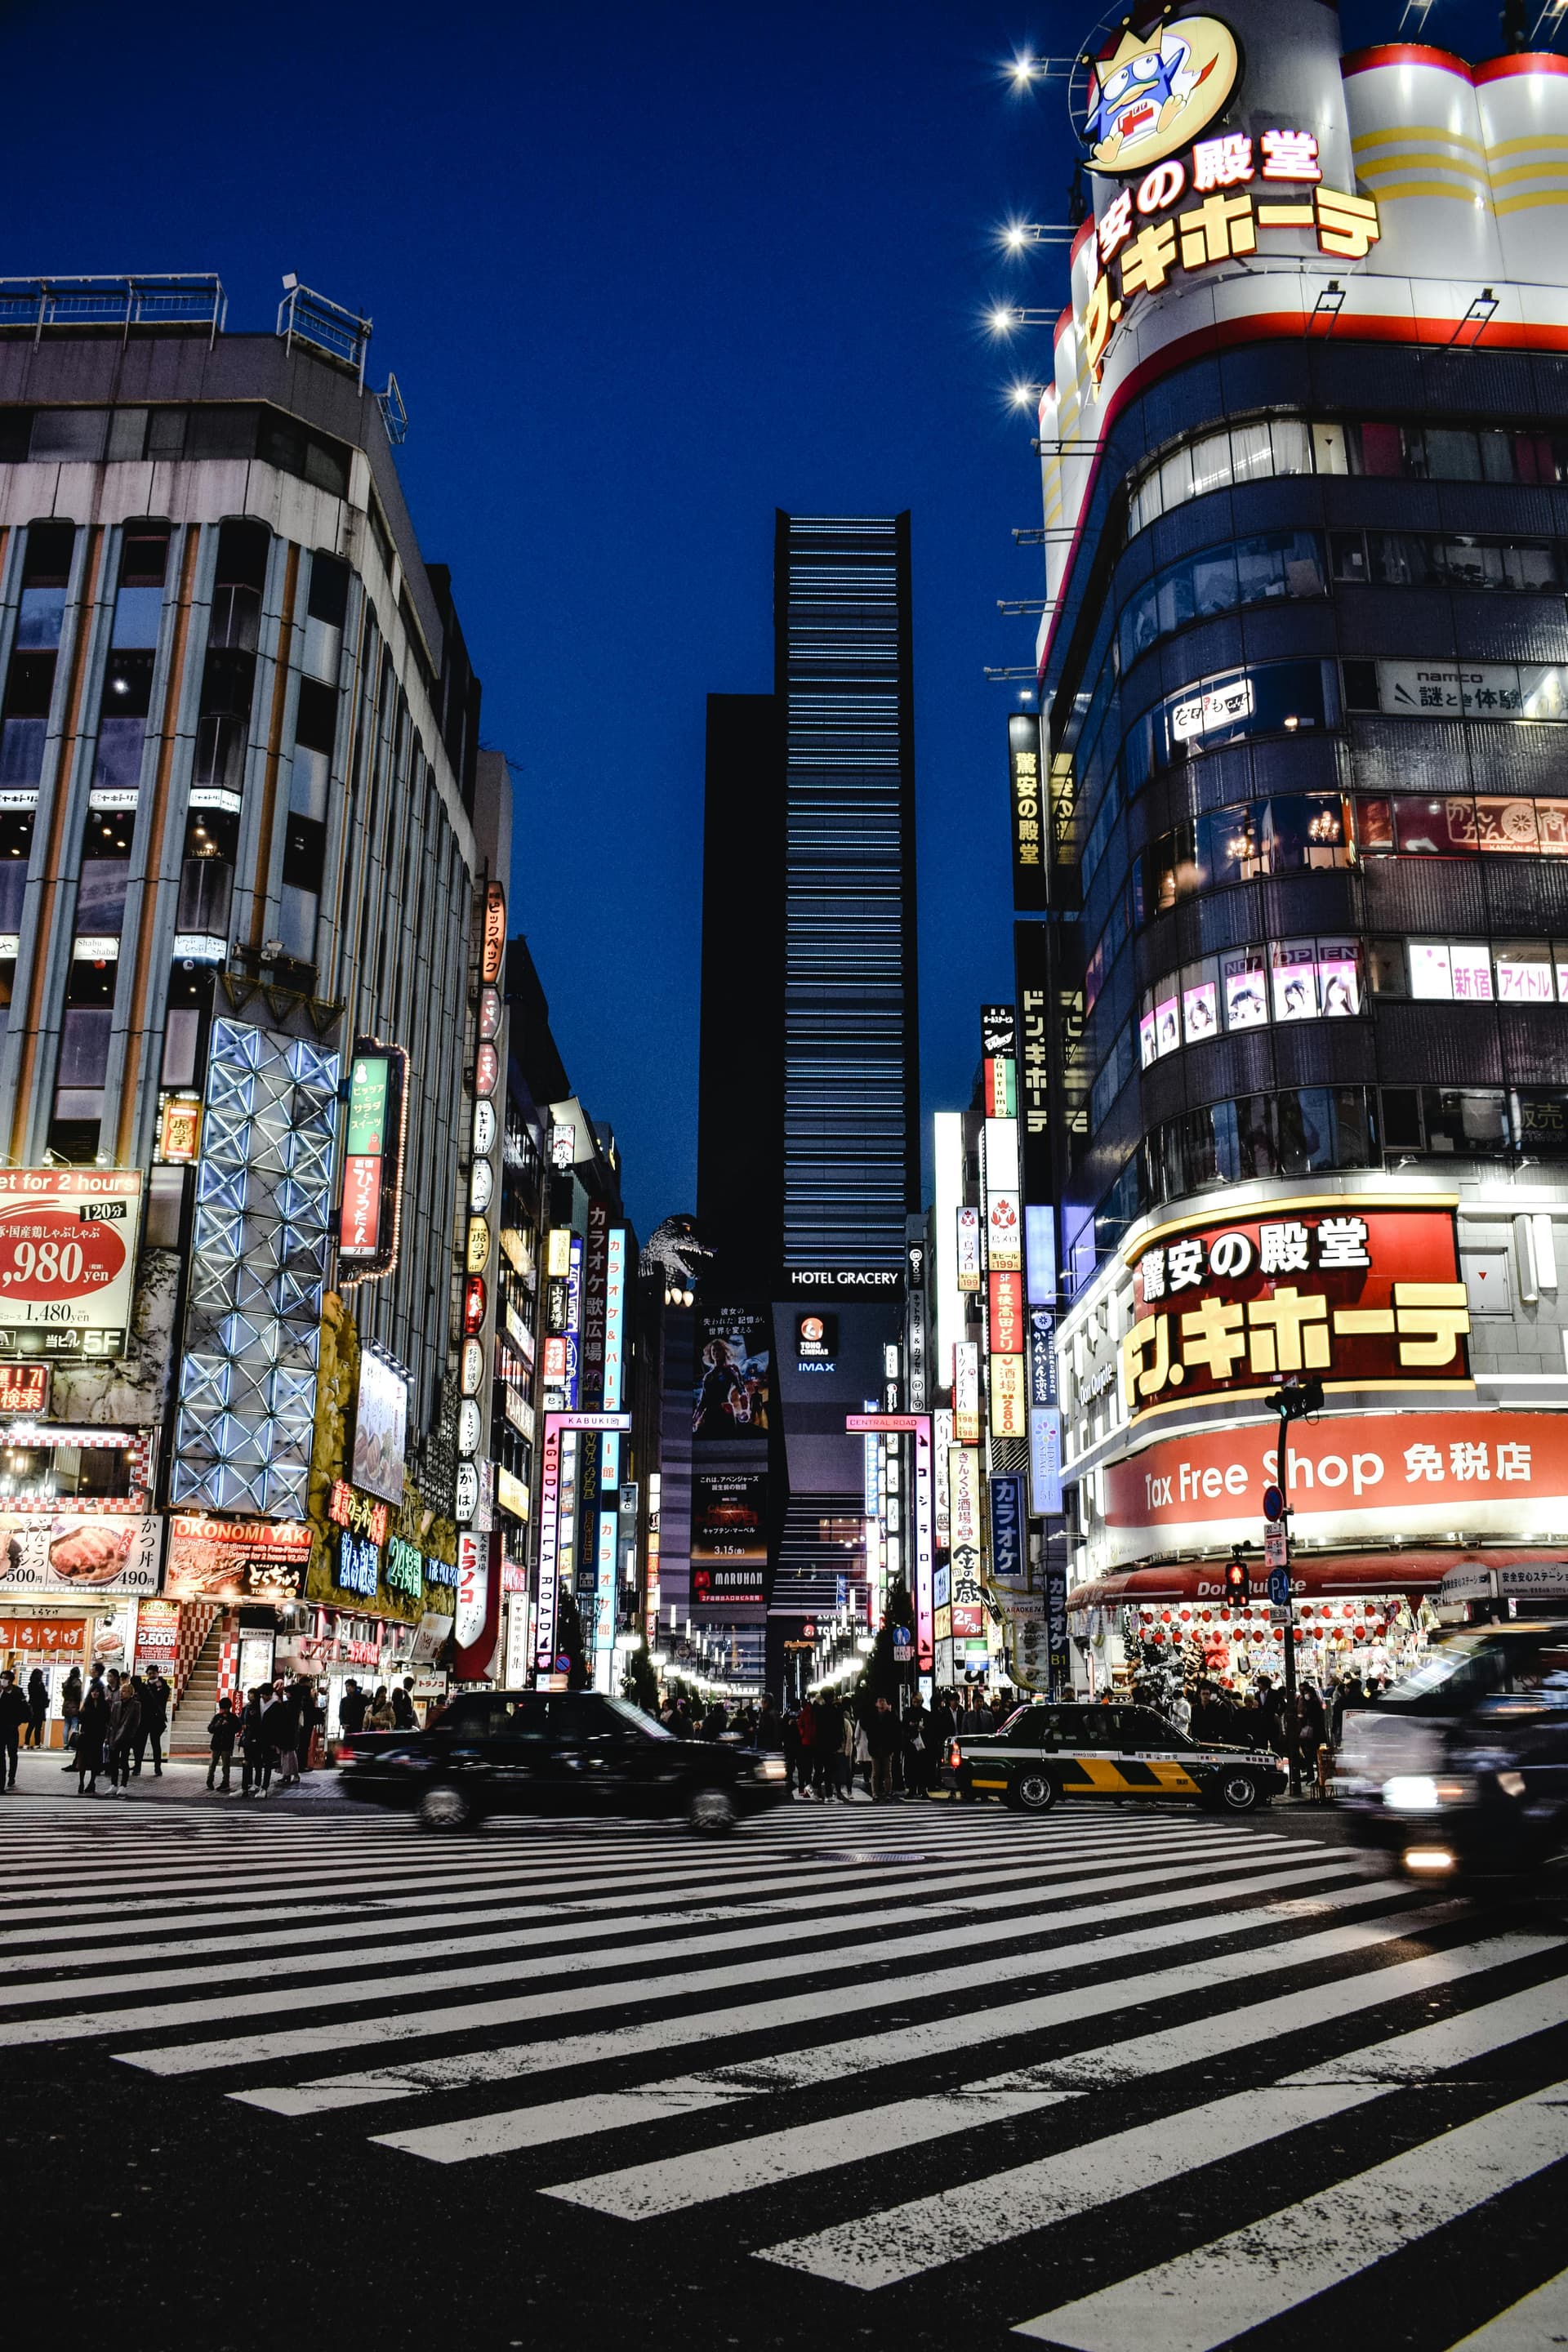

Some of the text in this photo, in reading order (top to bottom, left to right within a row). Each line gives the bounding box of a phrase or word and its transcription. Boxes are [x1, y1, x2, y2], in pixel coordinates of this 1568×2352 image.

[1089, 130, 1322, 270] 安の殿堂
[1417, 671, 1483, 684] namco
[1015, 752, 1040, 865] 驚安の殿堂
[1489, 844, 1523, 852] KANKAN
[1454, 967, 1490, 998] 新宿
[1023, 990, 1048, 1133] ドン・キホーテ
[353, 1102, 381, 1111] サラダ
[173, 1117, 189, 1146] 虎の子
[351, 1119, 381, 1129] スイーツ
[355, 1160, 373, 1169] 新宿
[24, 1174, 52, 1191] for
[58, 1174, 71, 1191] 2
[78, 1174, 135, 1192] hours
[83, 1204, 123, 1222] 120分
[354, 1168, 373, 1244] ひょうたん
[353, 1247, 366, 1255] 7F
[471, 1233, 487, 1259] 虎の子
[1141, 1216, 1372, 1304] 驚安の殿堂
[83, 1270, 109, 1284] yen
[585, 1206, 606, 1362] カラオケ歌広場
[791, 1272, 899, 1285] HOTEL GRACERY
[1000, 1274, 1010, 1282] 5F
[25, 1303, 90, 1323] 1,480 yen
[702, 1316, 734, 1326] 失われた
[720, 1307, 745, 1316] 彼女の
[83, 1330, 121, 1353] 5F
[798, 1362, 836, 1372] IMAX
[1033, 1330, 1048, 1401] かんかん商店
[1000, 1368, 1016, 1392] 酒場
[1, 1388, 41, 1409] 検索
[1003, 1400, 1013, 1430] 280
[957, 1452, 972, 1524] きんくら酒場
[1145, 1441, 1532, 1512] Tax Free Shop 免税店
[176, 1521, 312, 1545] OKONOMI YAKI
[996, 1481, 1018, 1570] カラオケ
[19, 1518, 32, 1566] ラーメン
[33, 1518, 46, 1567] とんこつ
[139, 1518, 157, 1567] かつ丼
[539, 1449, 557, 1631] GODZILLA ROAD
[917, 1467, 930, 1621] ゴジラロード
[229, 1551, 251, 1559] Drinks
[7, 1568, 42, 1584] 500円
[118, 1570, 155, 1585] 490円
[460, 1534, 488, 1603] トラノコ 大衆酒場
[599, 1523, 613, 1635] カラオケ館
[715, 1572, 763, 1585] MARUHAN
[953, 1544, 980, 1604] 金の蔵
[1271, 1577, 1280, 1601] P
[954, 1609, 972, 1625] 2F
[1049, 1578, 1066, 1650] カラオケ
[138, 1633, 176, 1646] 2,500円
[1051, 1654, 1067, 1665] B1
[419, 1680, 443, 1688] トラノコ
